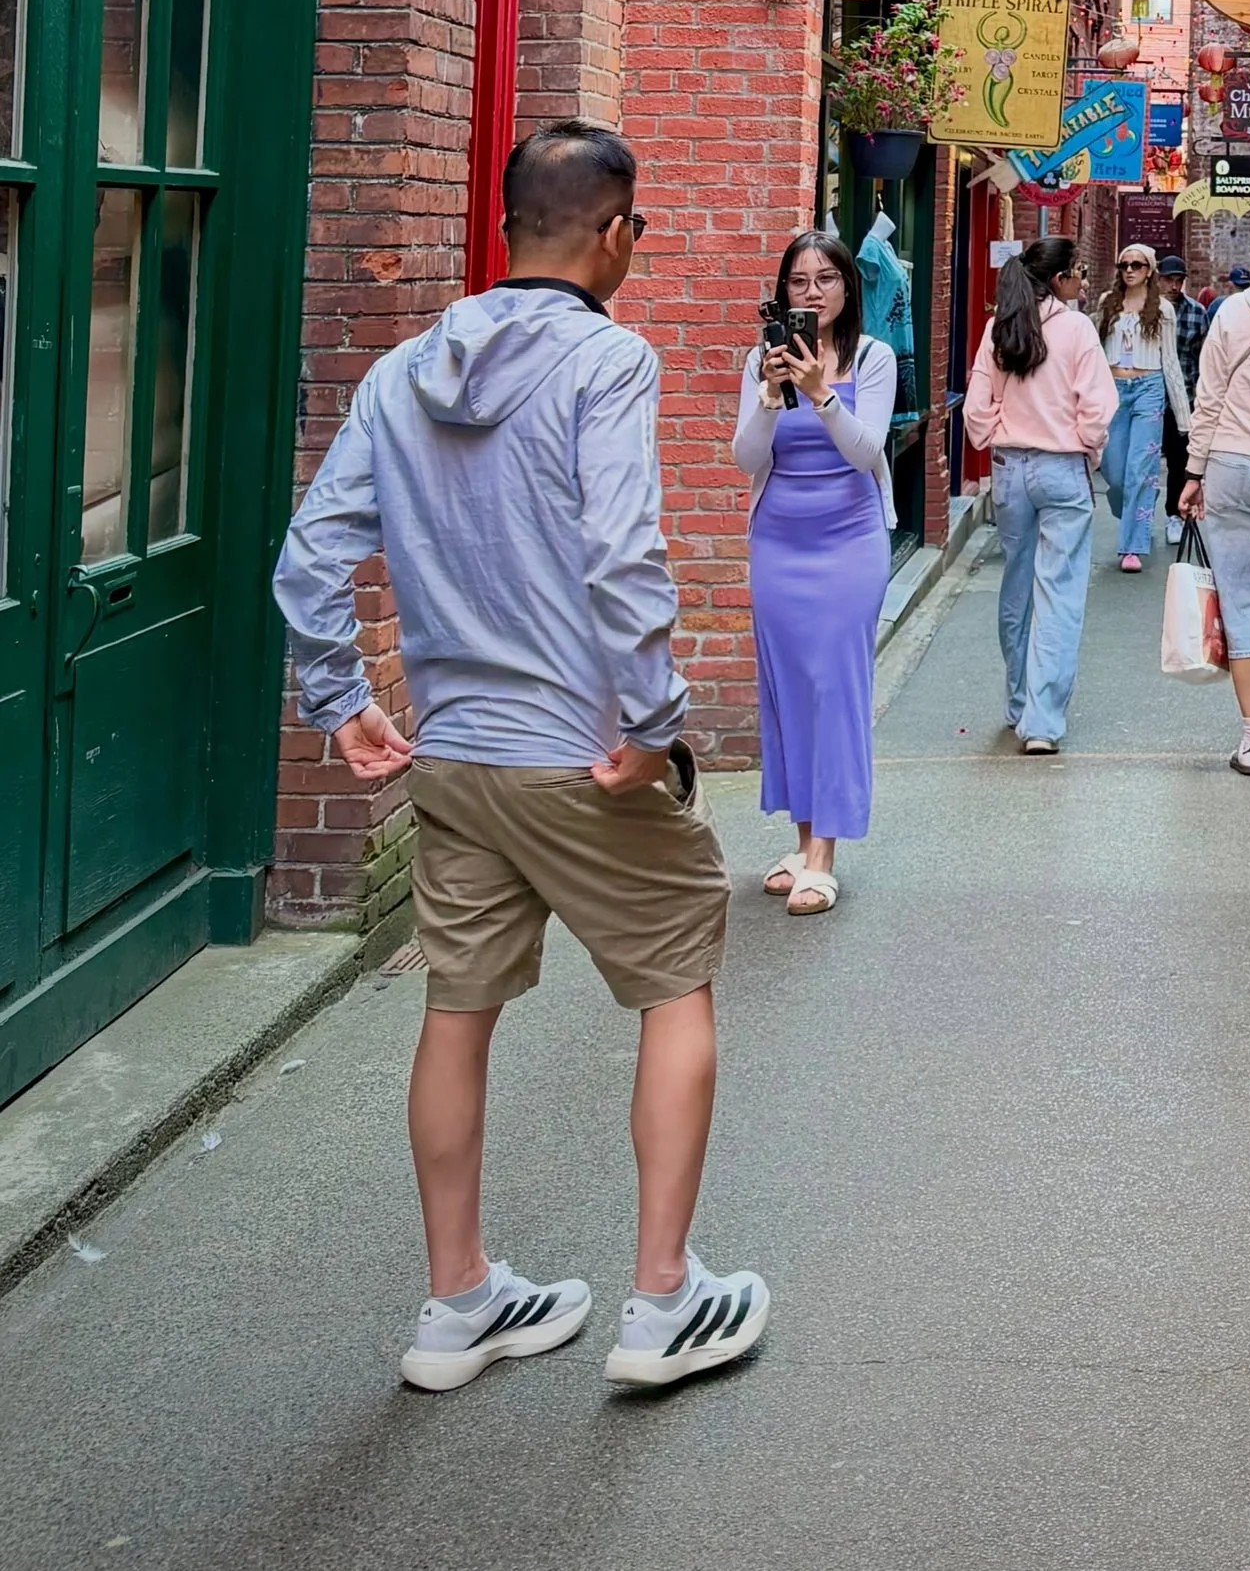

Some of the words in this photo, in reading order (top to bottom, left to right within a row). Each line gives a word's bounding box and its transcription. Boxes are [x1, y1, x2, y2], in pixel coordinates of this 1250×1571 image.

[1022, 52, 1061, 62] CANDLES
[1031, 70, 1059, 79] TAROT
[1017, 87, 1059, 97] CRYSTALS
